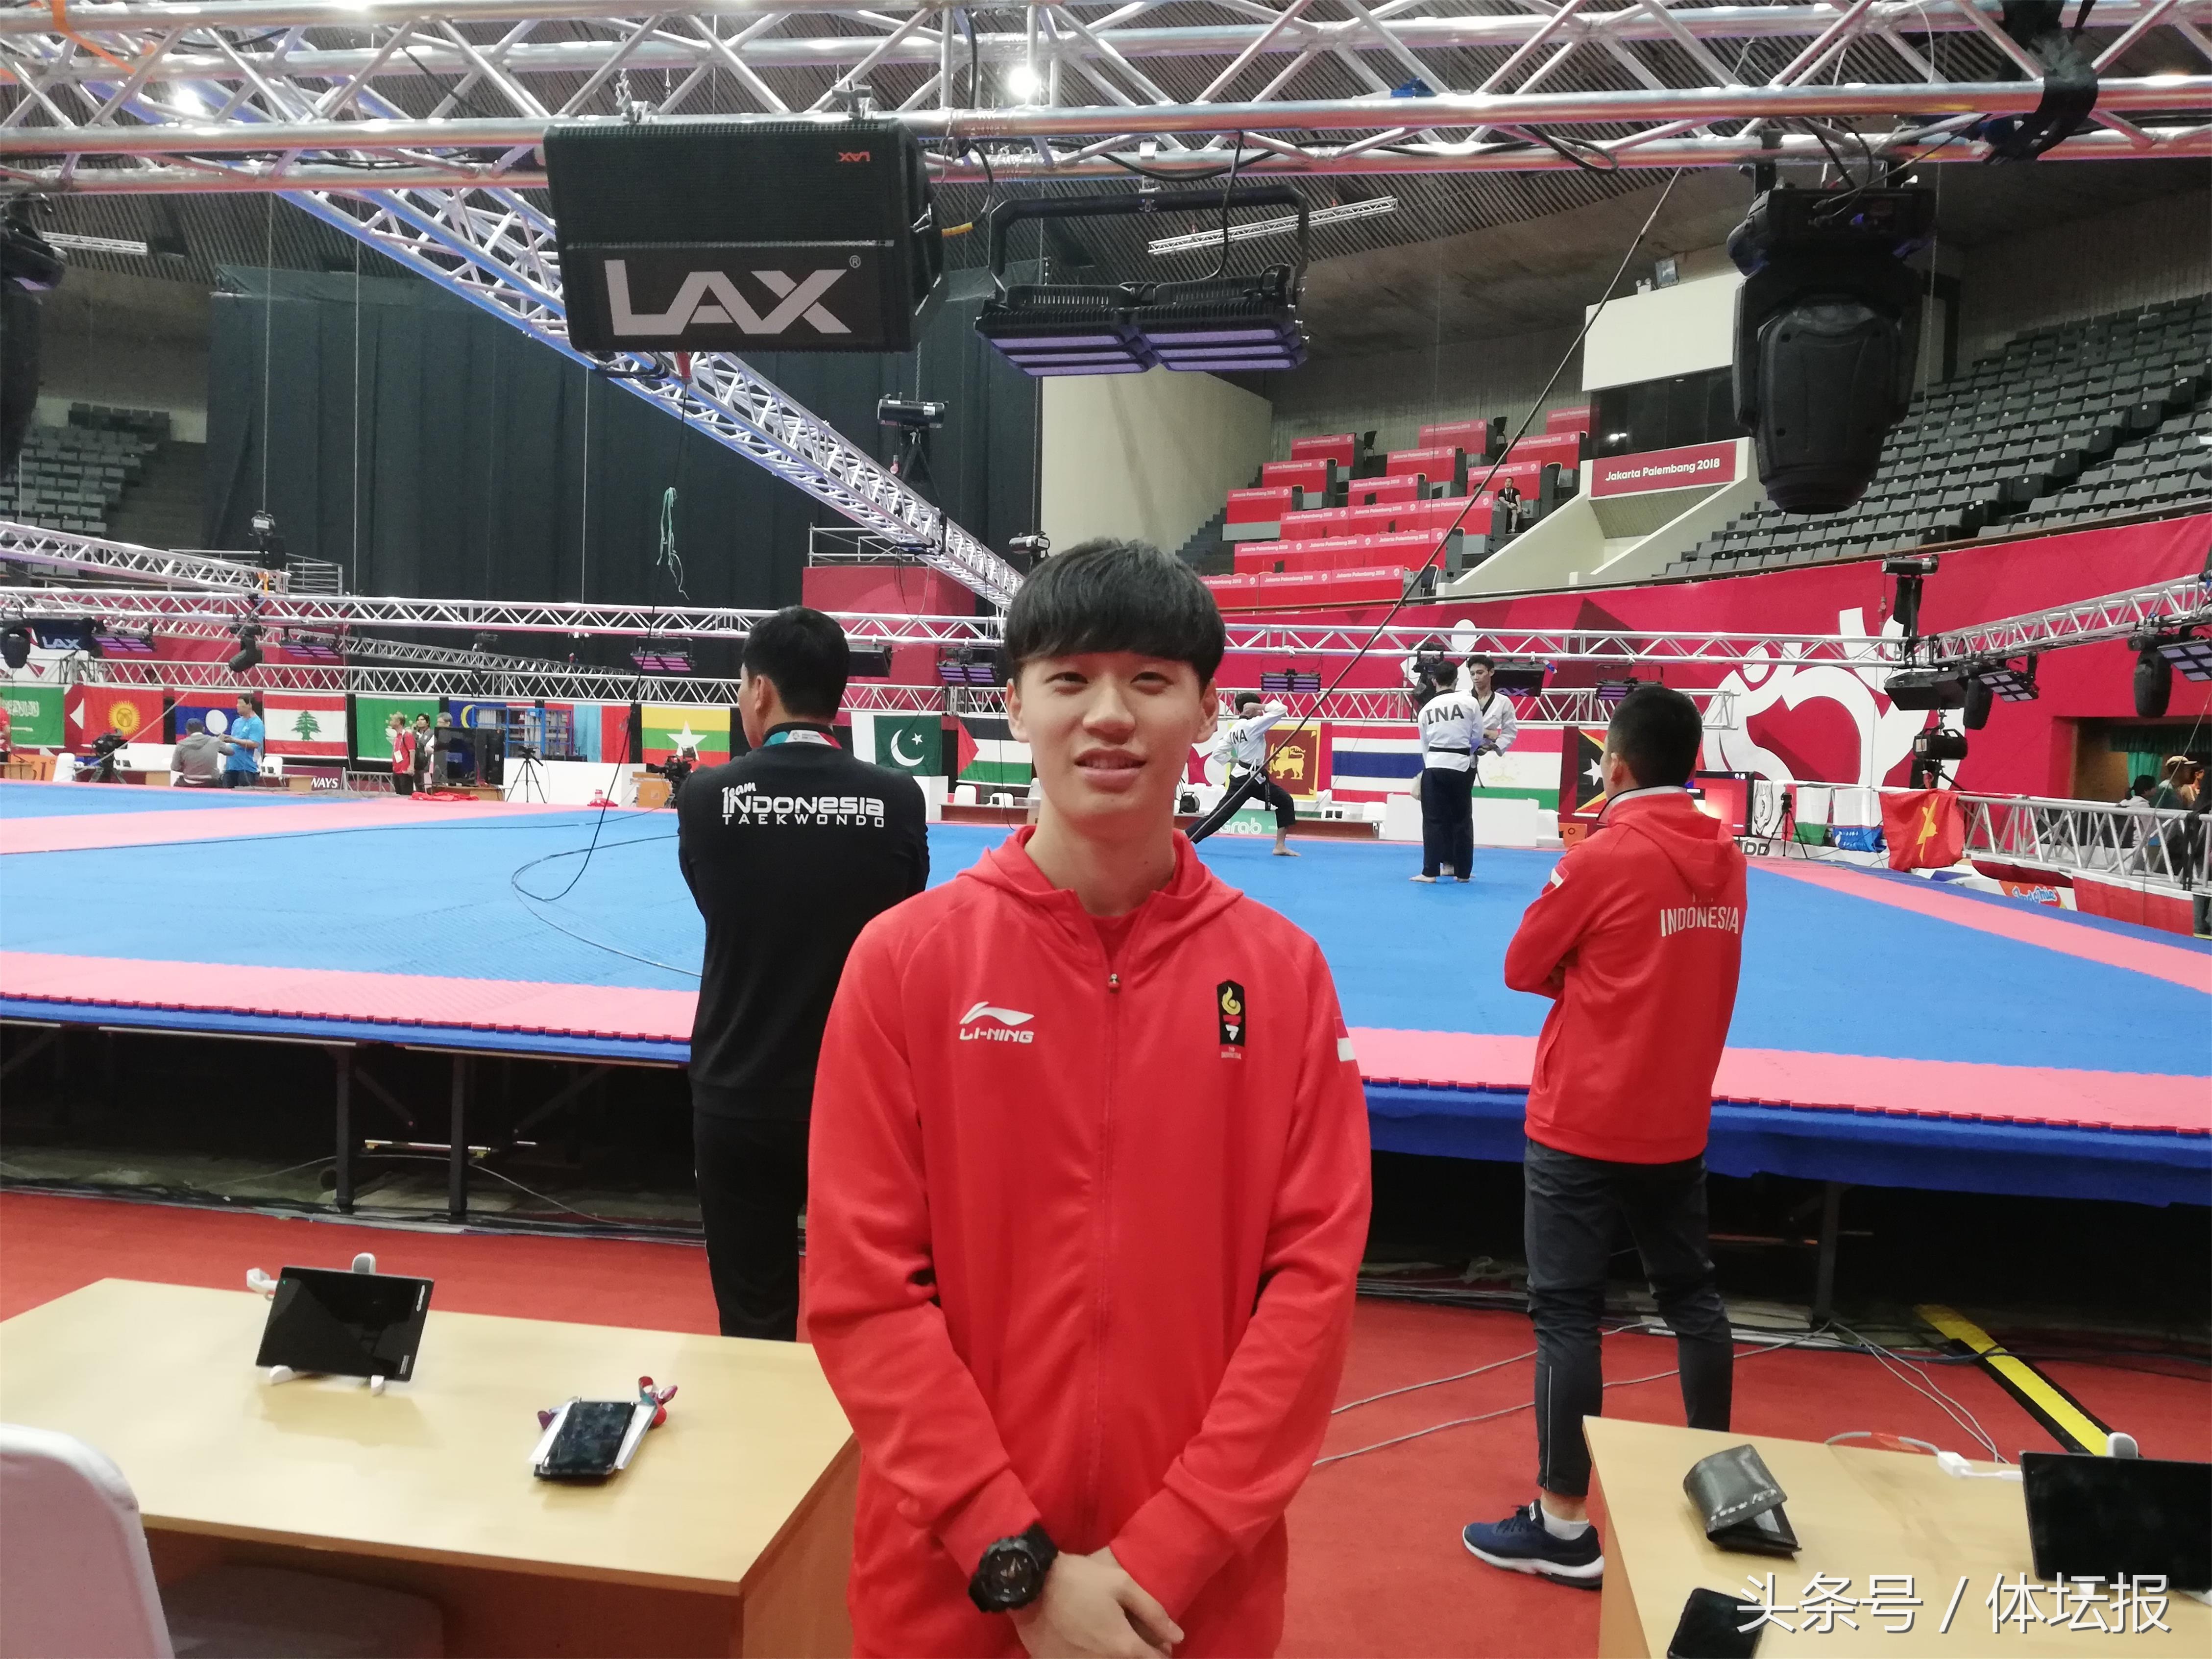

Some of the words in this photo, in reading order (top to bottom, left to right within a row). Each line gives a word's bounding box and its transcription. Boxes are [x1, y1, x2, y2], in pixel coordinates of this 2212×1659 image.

[605, 259, 851, 336] LAX
[1605, 469, 1641, 481] Jakarta
[1642, 463, 1696, 477] Palembang
[1697, 458, 1720, 470] 2018
[41, 636, 82, 650] LAX
[1426, 704, 1464, 725] INA
[1230, 729, 1248, 744] INA
[722, 782, 756, 799] Team
[722, 814, 884, 828] TAEKWONDO
[1660, 906, 1739, 937] INDONESIA
[959, 1027, 1034, 1043] LI-NING
